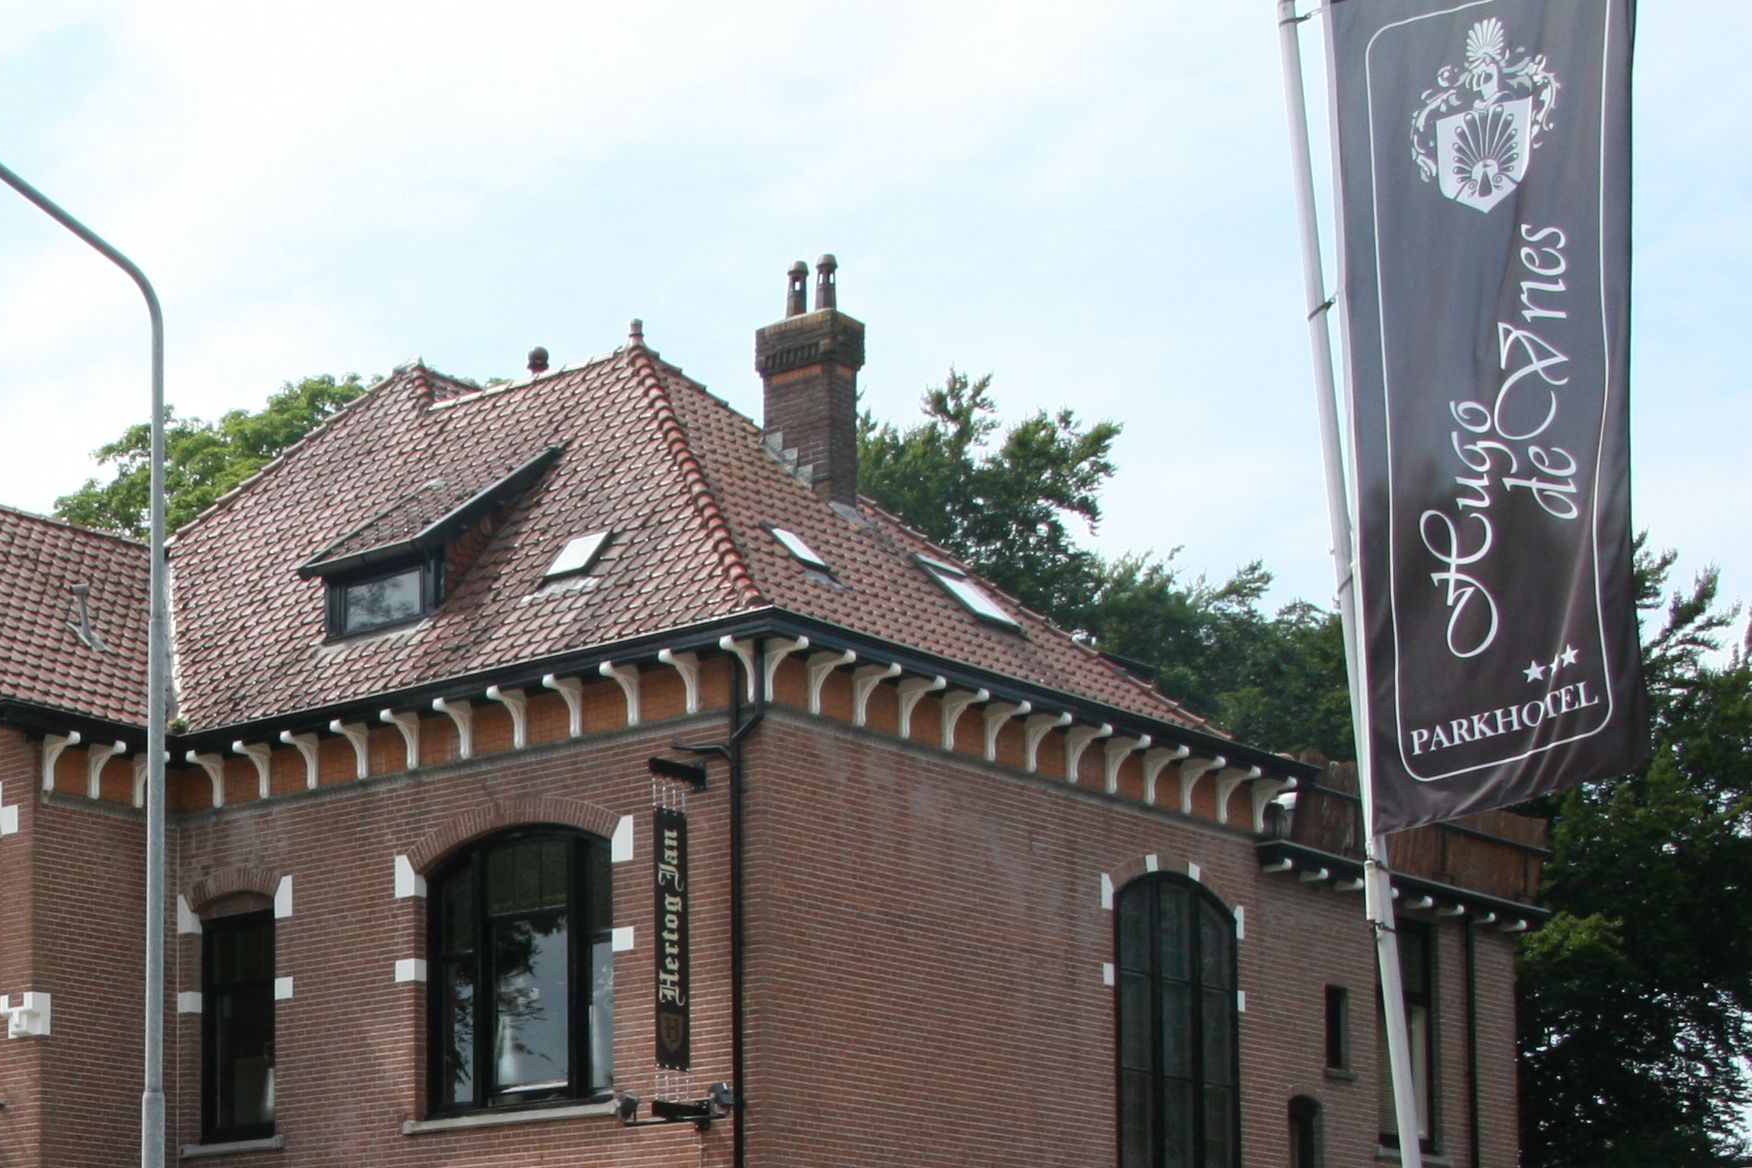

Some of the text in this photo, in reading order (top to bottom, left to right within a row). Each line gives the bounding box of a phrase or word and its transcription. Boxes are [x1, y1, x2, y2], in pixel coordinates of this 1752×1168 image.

[1493, 223, 1579, 520] de Vries
[1418, 400, 1518, 658] Hugo
[1410, 681, 1600, 756] PARKHOTEL
[658, 829, 685, 1006] Hertog Jan
